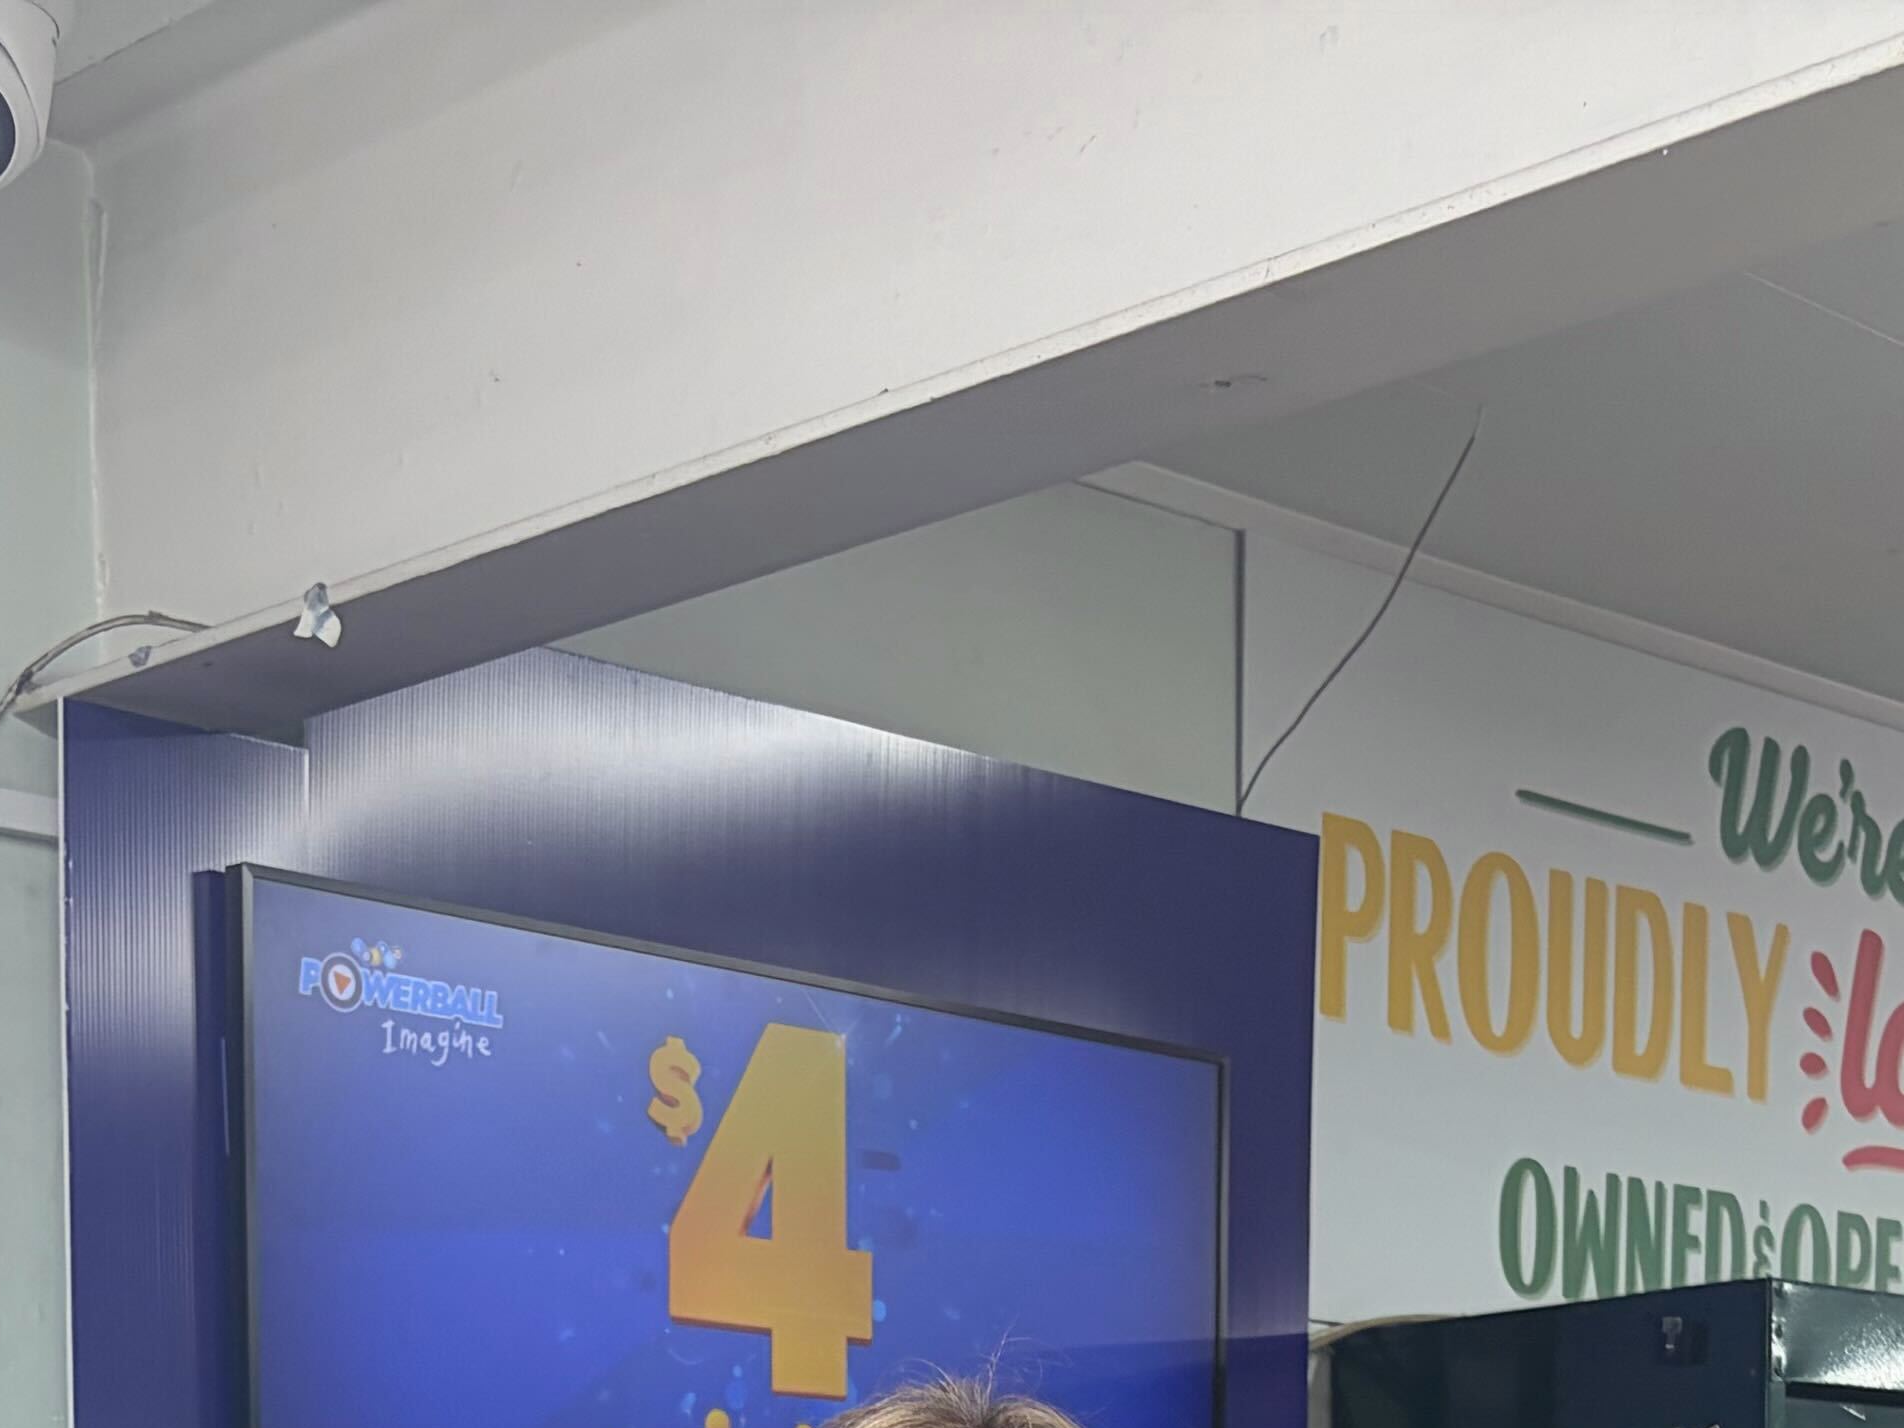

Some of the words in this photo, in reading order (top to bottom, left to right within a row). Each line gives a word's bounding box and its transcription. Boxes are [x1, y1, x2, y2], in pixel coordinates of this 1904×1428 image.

[298, 952, 504, 1028] POWERBALL
[1317, 810, 1792, 1104] PROUDLY
[380, 1018, 493, 1067] Imagine
[1498, 1155, 1746, 1303] OWNED
